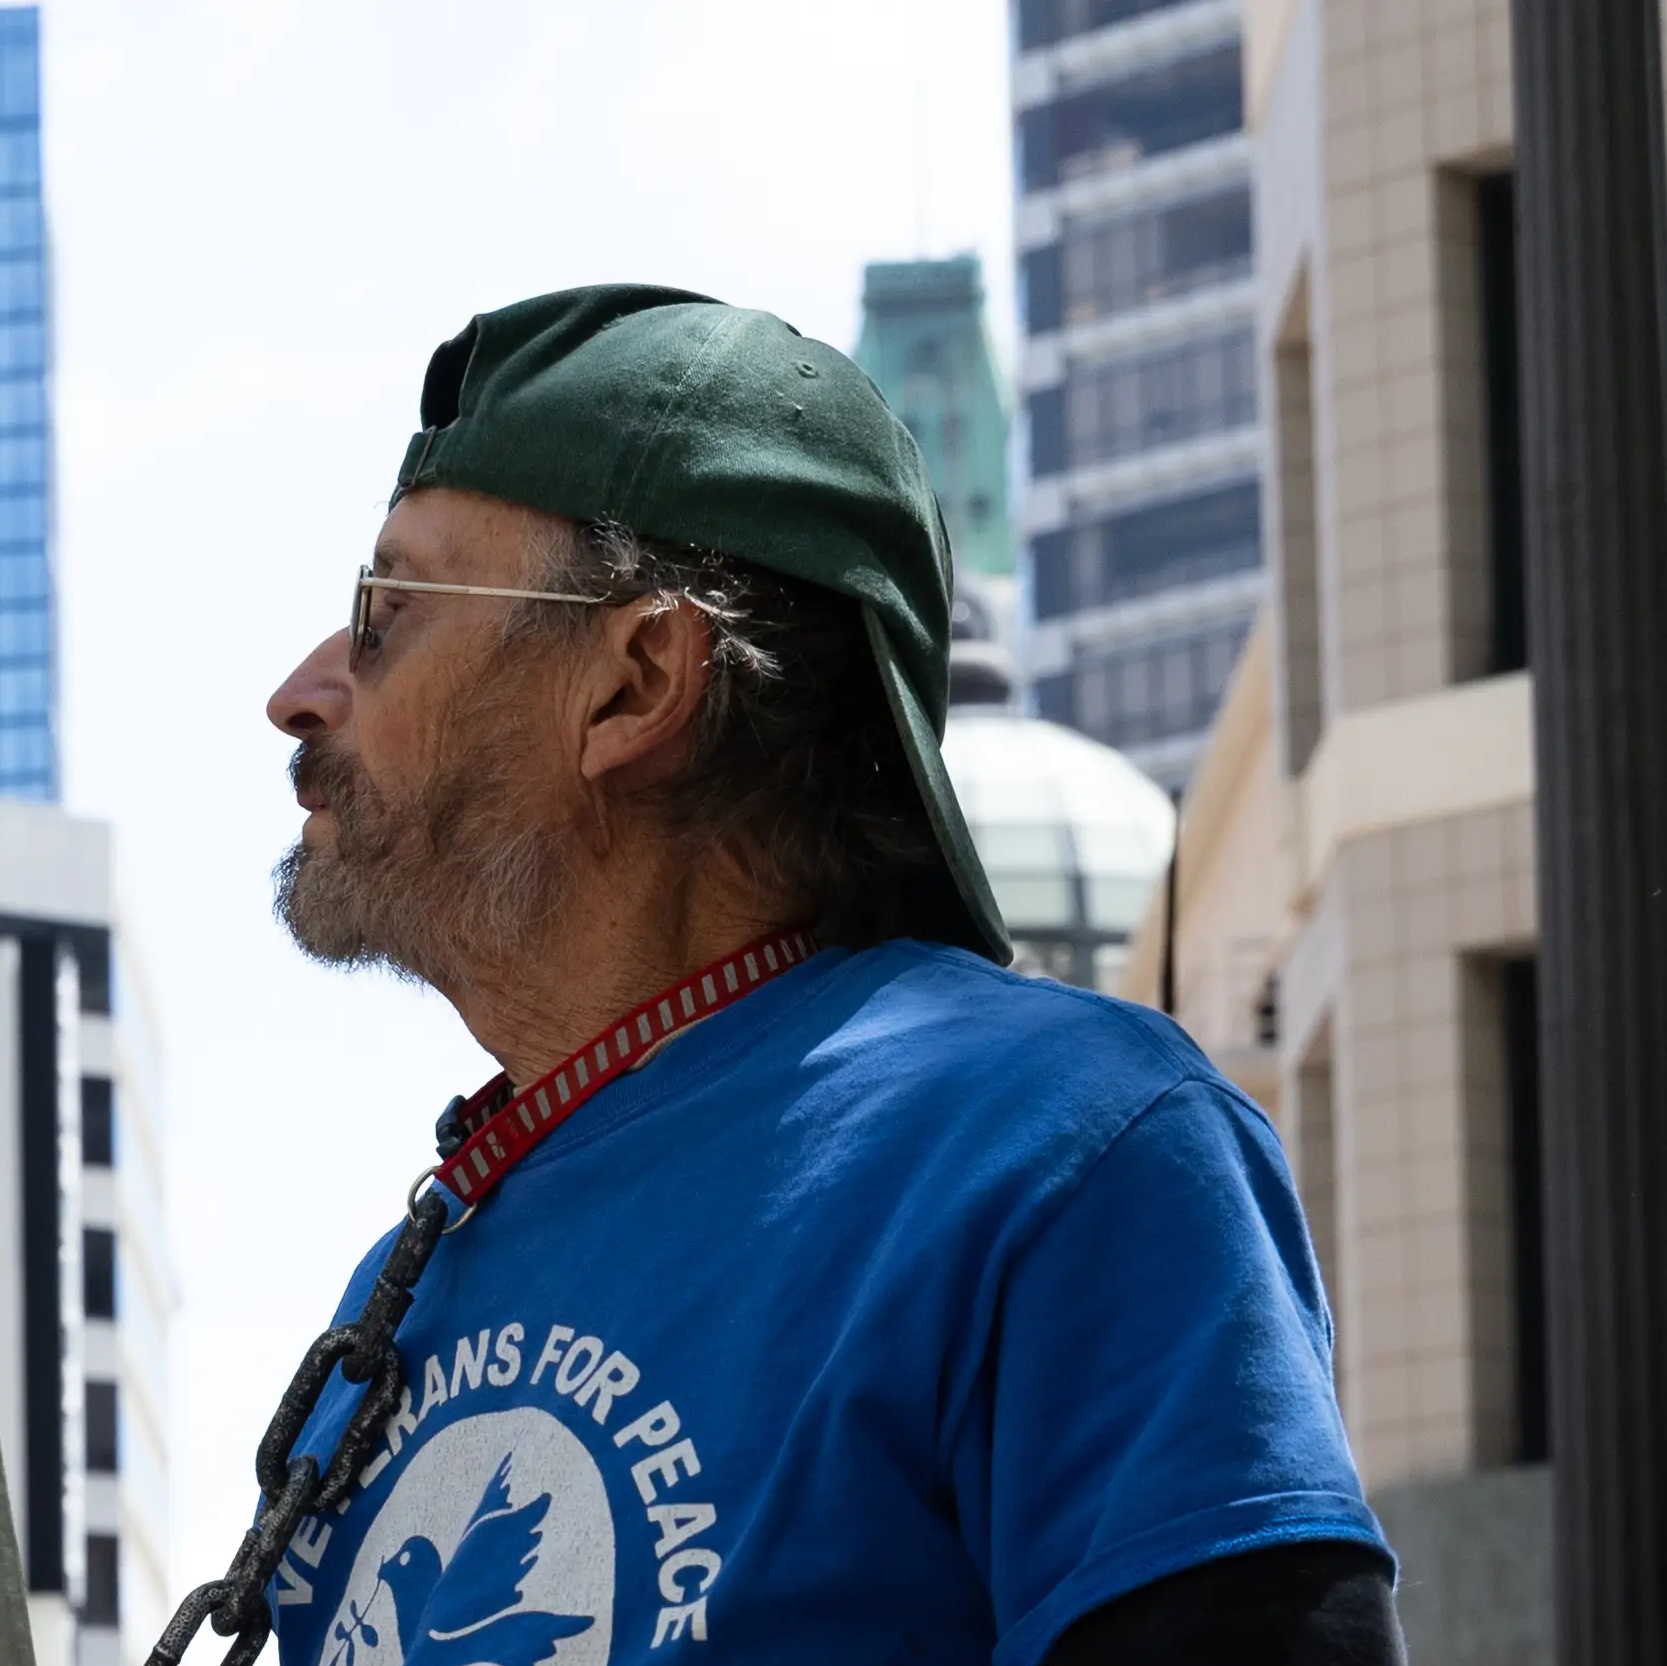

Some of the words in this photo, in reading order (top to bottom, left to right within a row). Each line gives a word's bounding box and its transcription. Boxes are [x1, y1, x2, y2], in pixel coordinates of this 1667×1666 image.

[277, 1322, 525, 1606] VERANS
[529, 1324, 641, 1425] FOR
[612, 1399, 723, 1650] PEACE
